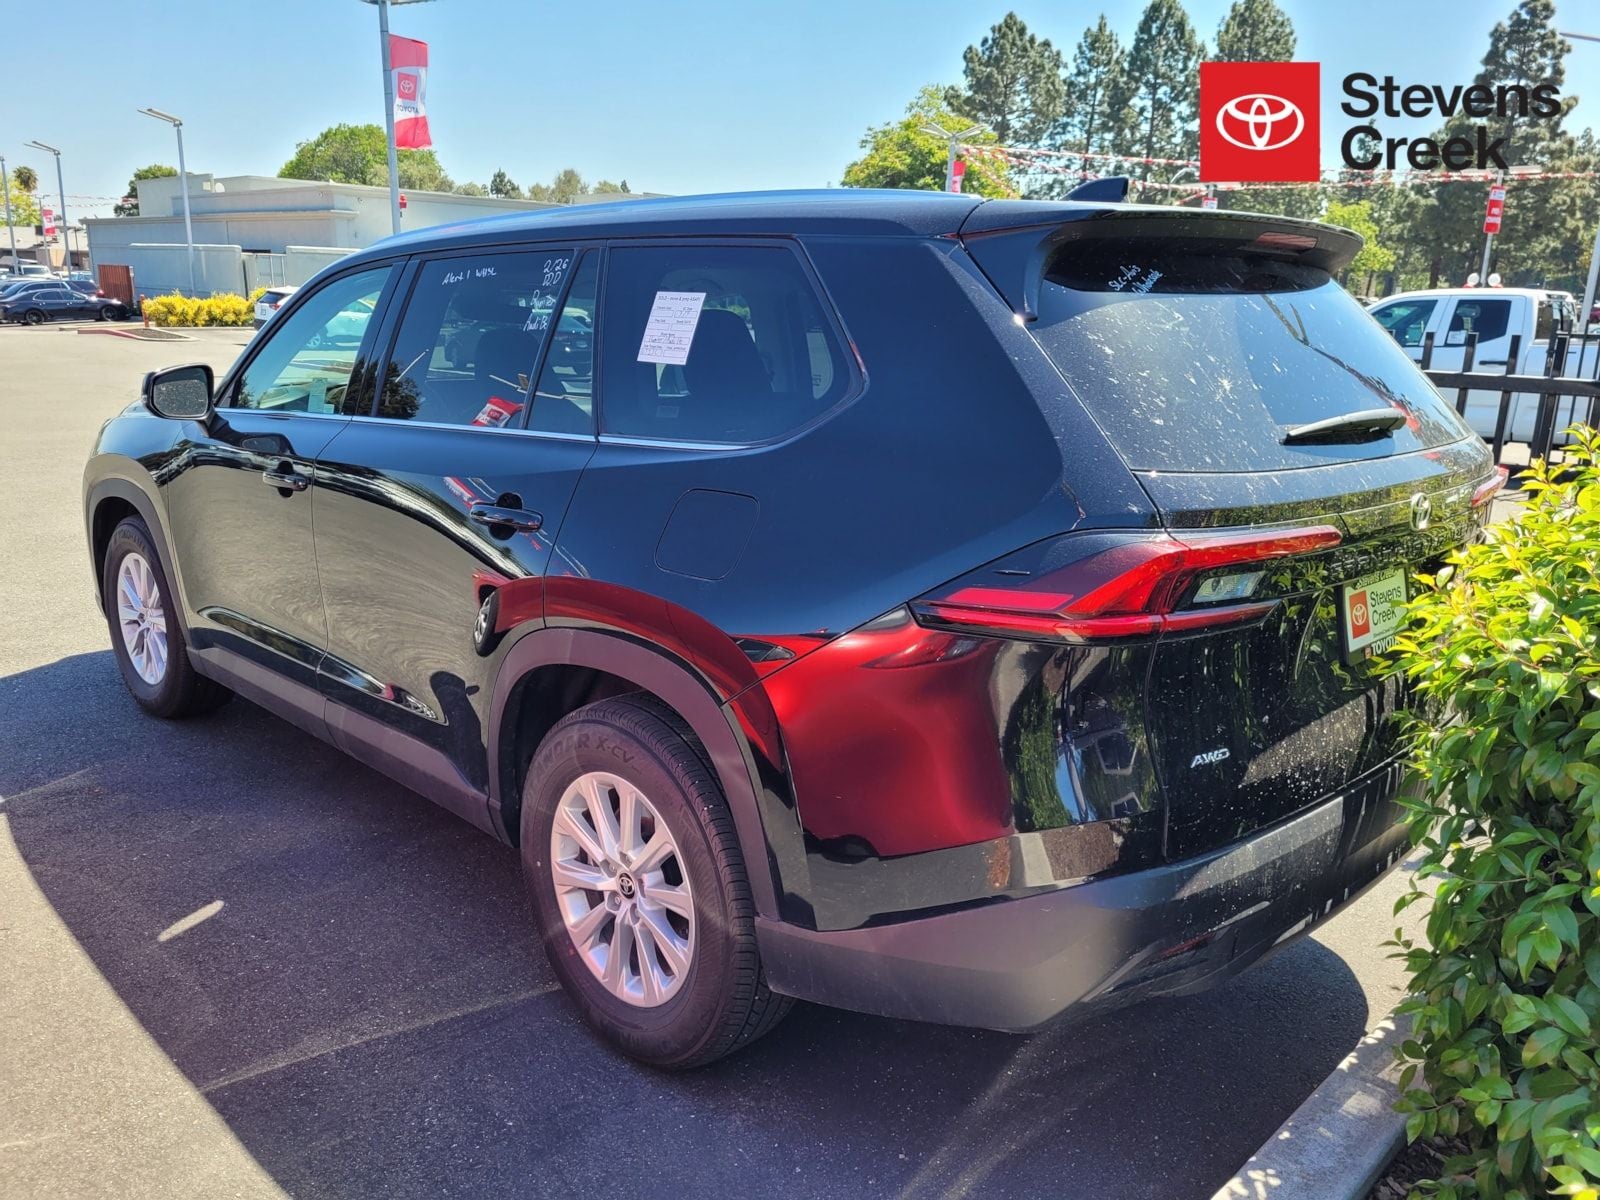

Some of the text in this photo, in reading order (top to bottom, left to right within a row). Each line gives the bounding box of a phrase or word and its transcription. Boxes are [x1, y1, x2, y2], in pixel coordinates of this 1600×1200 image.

[396, 104, 419, 114] TOYOTA
[1369, 586, 1402, 608] Stevens
[1372, 606, 1397, 626] Creek
[1190, 747, 1231, 768] AWD
